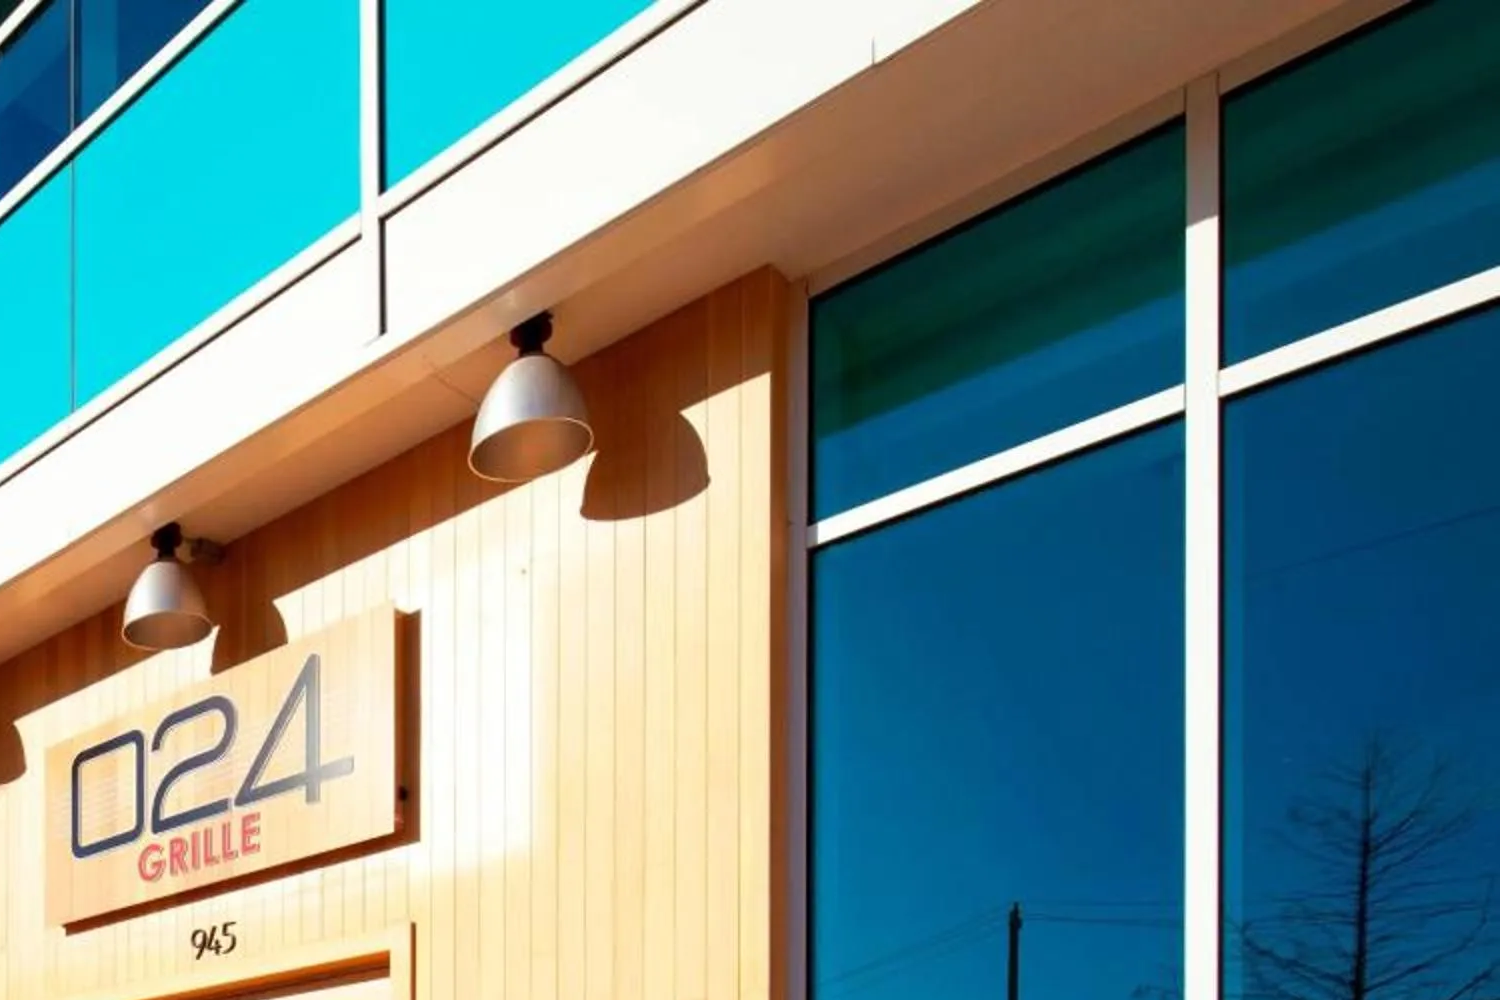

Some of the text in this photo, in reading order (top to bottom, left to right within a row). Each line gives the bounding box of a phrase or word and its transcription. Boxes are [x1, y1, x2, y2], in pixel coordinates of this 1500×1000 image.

[71, 653, 355, 859] 024
[137, 812, 261, 883] GRILLE
[190, 921, 237, 960] 945
